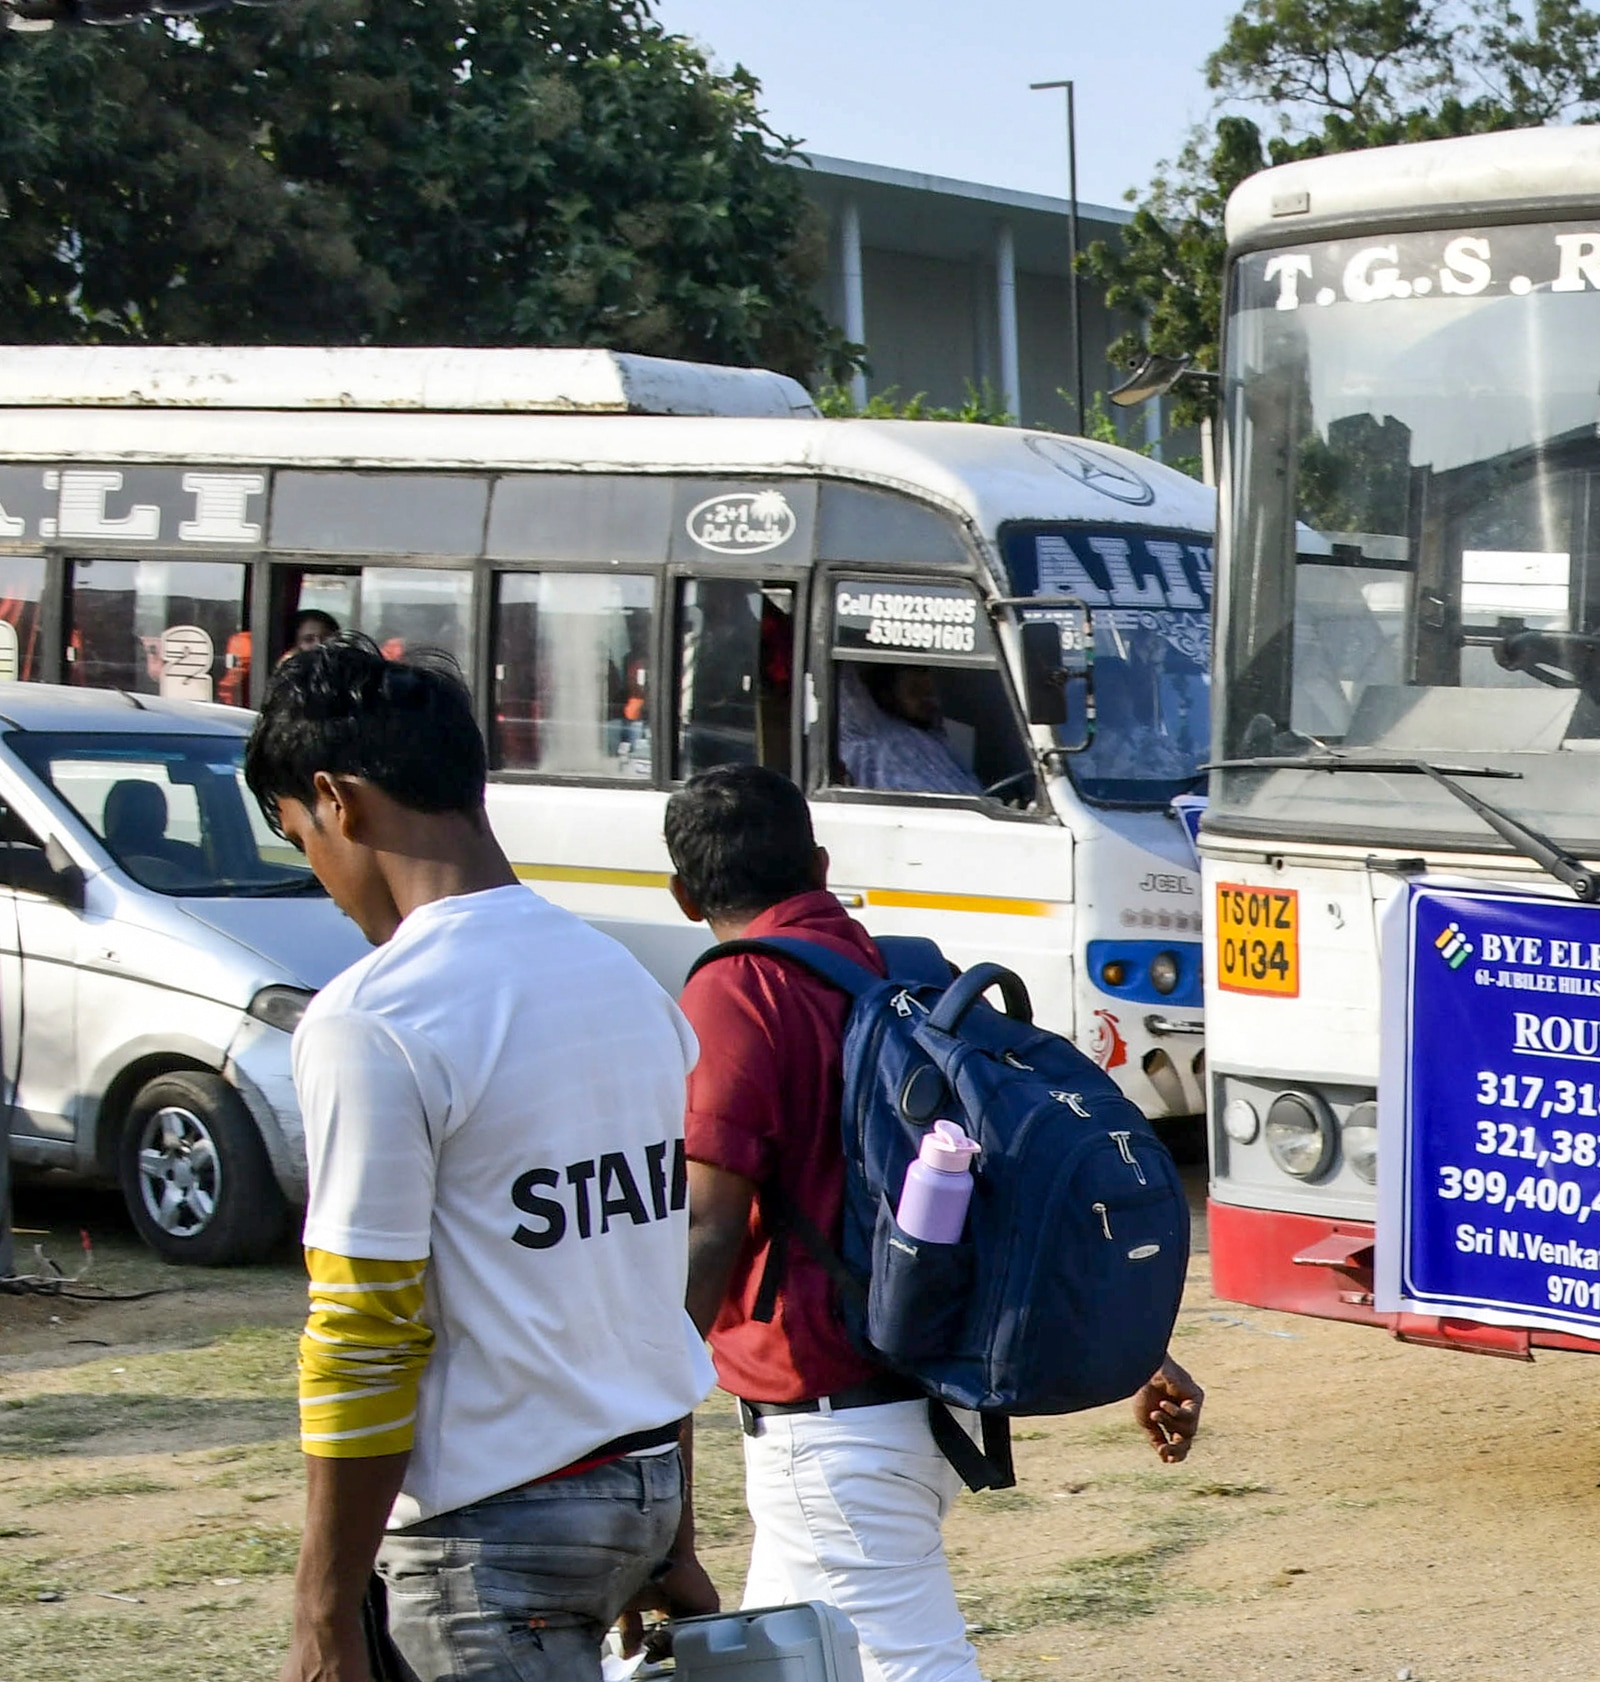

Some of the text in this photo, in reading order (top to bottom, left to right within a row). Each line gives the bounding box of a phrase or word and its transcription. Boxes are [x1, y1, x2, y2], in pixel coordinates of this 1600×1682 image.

[1221, 890, 1291, 929] TS01Z
[1223, 938, 1290, 980] 0134
[1481, 933, 1542, 967] BYE
[1475, 969, 1556, 993] 61-JUBILEE
[1456, 1224, 1493, 1256] Sri
